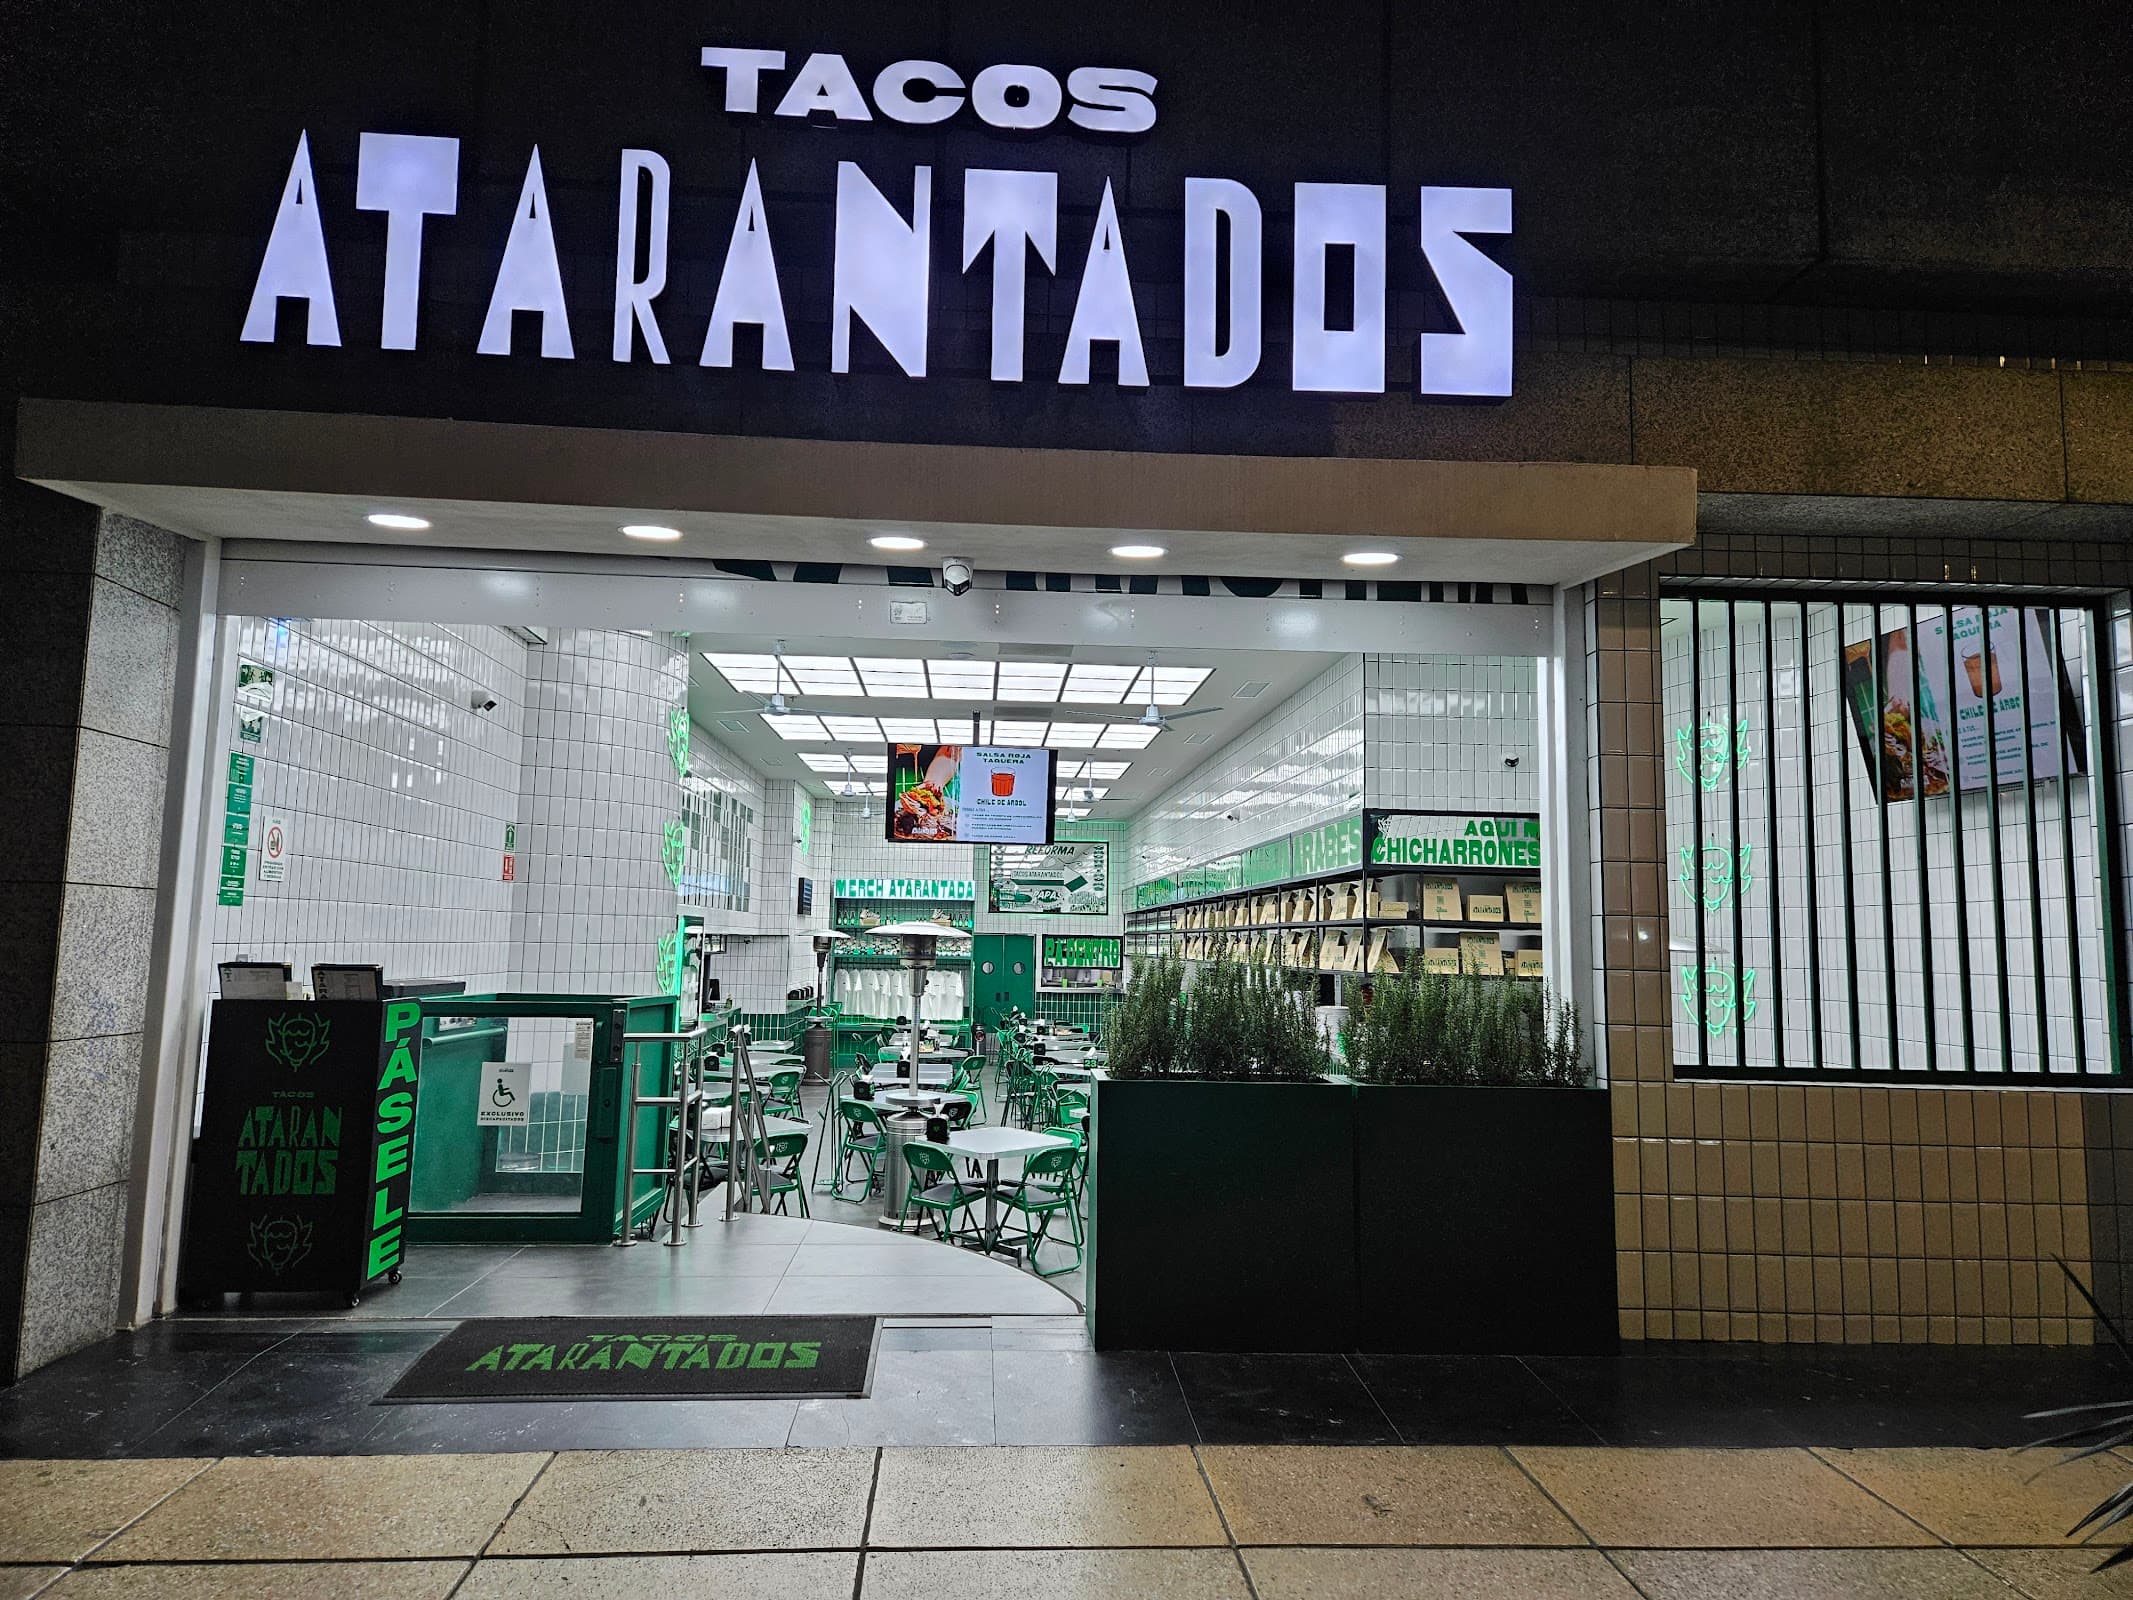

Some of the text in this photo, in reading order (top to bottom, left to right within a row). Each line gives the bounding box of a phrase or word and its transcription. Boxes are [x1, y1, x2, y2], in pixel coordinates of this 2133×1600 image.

[701, 47, 1158, 132] TACOS
[240, 129, 1514, 397] ATARANTADOS
[1025, 845, 1075, 855] REFORMA
[1372, 836, 1541, 866] CHICHARRONES
[835, 879, 973, 898] MERCH ATARANTADA
[272, 1090, 315, 1099] TACOS
[239, 1105, 343, 1148] ATARAN
[367, 1003, 421, 1280] PÁSELE
[235, 1149, 339, 1196] TADOS
[587, 1334, 738, 1342] TACOS
[465, 1342, 822, 1372] ATARANTADOS
